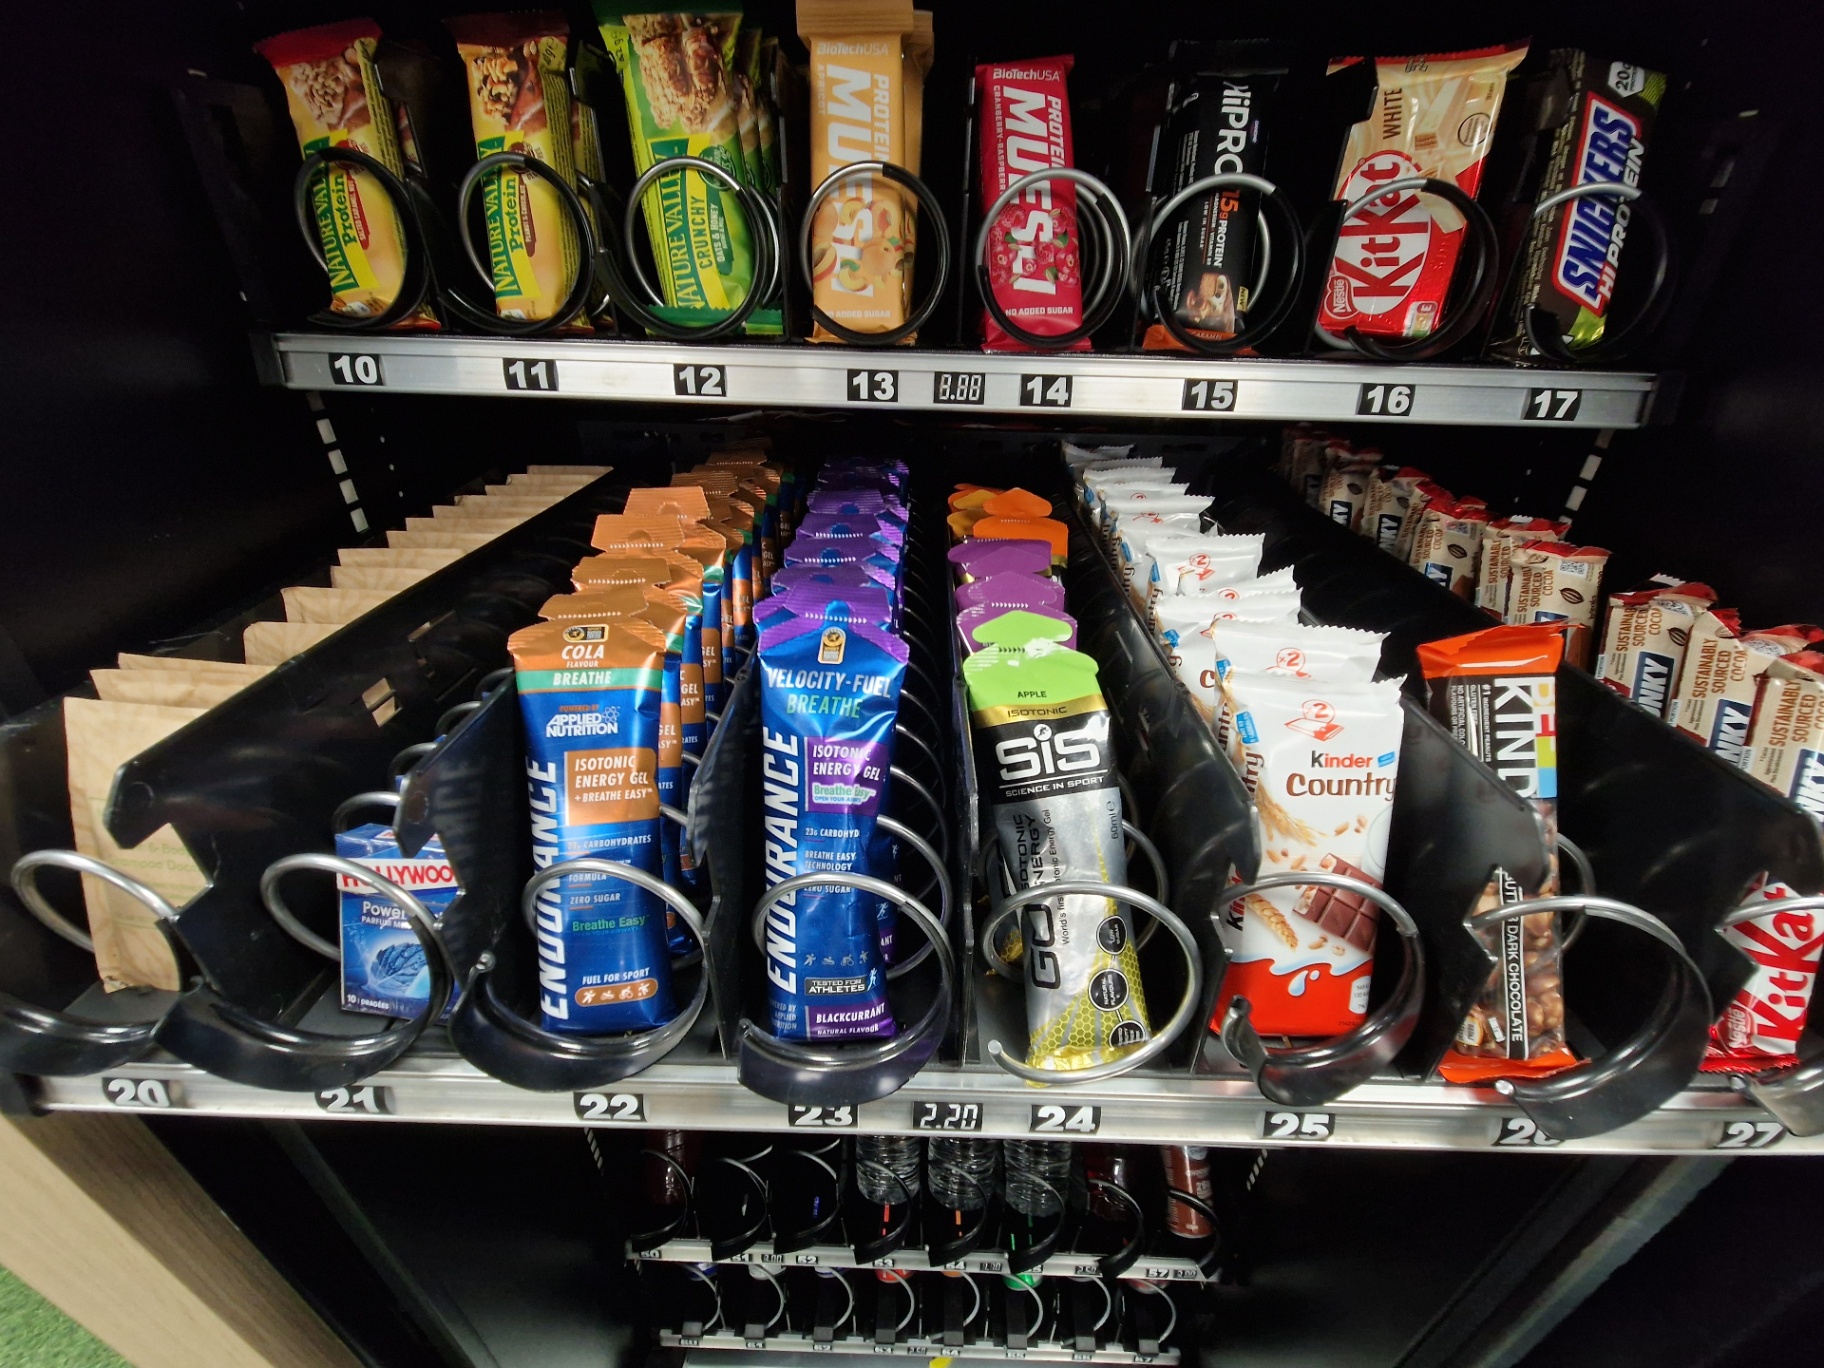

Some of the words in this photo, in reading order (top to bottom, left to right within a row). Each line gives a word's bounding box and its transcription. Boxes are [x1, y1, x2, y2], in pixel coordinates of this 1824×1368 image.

[993, 68, 1061, 82] BioTechUSA
[1383, 88, 1403, 140] WHITE
[1047, 95, 1066, 168] PROTEI
[333, 173, 358, 247] Protein
[503, 177, 525, 252] Protein
[1607, 135, 1646, 267] PROEIN
[710, 203, 719, 231] HONEY
[690, 195, 714, 270] CRUNCHY
[712, 232, 721, 240] &
[1213, 220, 1229, 268] PROTEIN
[319, 213, 358, 289] NATURE
[489, 216, 520, 291] NATURE
[713, 241, 726, 263] OATS
[1240, 288, 1248, 308] NEW
[1333, 279, 1349, 313] Nestlé
[1018, 307, 1046, 316] ADDED
[1047, 306, 1074, 315] SUGAR
[334, 355, 378, 385] 10
[508, 361, 549, 389] 11
[678, 366, 721, 395] 12
[852, 373, 895, 400] 13
[1025, 376, 1070, 405] 14
[1189, 381, 1233, 410] 15
[1365, 386, 1411, 415] 16
[1532, 390, 1579, 419] 17
[1529, 572, 1543, 608] SOURCED
[1616, 607, 1635, 652] SUSTAINAB
[561, 645, 605, 660] COLA
[553, 671, 612, 685] BREATHE
[1692, 638, 1718, 699] SUSTAINABLY
[1711, 650, 1731, 694] SOURCED
[1017, 690, 1047, 699] APPLE
[1457, 684, 1464, 695] NO
[548, 713, 602, 726] APPLIED
[786, 694, 863, 719] BREATHE
[1007, 706, 1068, 718] ISOTONIC
[1457, 695, 1465, 727] ARTIFICIAL
[1769, 679, 1799, 748] SUSTAINABLY
[1792, 694, 1816, 743] SOURCED
[546, 722, 619, 738] NUTRITION
[575, 755, 637, 771] ISOTONIC
[813, 744, 872, 762] ISOTONIC
[995, 724, 1101, 781] SiS
[1311, 750, 1373, 768] Kinder
[575, 773, 625, 788] ENERGY
[630, 771, 649, 785] GEL
[813, 762, 861, 776] ENERGY
[863, 765, 881, 781] GEL
[813, 783, 852, 796] Breathe
[1005, 784, 1050, 797] SCIENCE
[1052, 782, 1065, 790] IN
[1067, 775, 1105, 788] SPORT
[1286, 771, 1397, 802] Country
[1042, 809, 1052, 825] Gel
[583, 834, 652, 849] CARBOHYDRATES
[1013, 814, 1030, 890] SOTONIC
[1025, 814, 1045, 885] NERGY
[1047, 826, 1057, 856] Energy
[804, 861, 853, 871] TECHNOLOGY
[805, 851, 834, 861] BREATHE
[836, 852, 856, 861] EASY
[340, 865, 454, 888] HLLYWOO
[824, 885, 852, 894] SUGAR
[569, 895, 591, 905] ZERO
[593, 893, 621, 903] SUGAR
[1056, 895, 1064, 910] firs
[572, 919, 615, 932] Breathe
[1059, 912, 1070, 945] World's
[1507, 925, 1519, 960] DARK
[582, 975, 602, 985] FUEL
[604, 973, 621, 983] FOR
[623, 967, 650, 982] SPORT
[808, 983, 866, 993] ATHLETES
[844, 978, 862, 986] FOR
[1108, 974, 1116, 1005] FLAVOURS
[346, 994, 357, 1004] 10
[1101, 976, 1109, 1005] NATURAL
[1508, 962, 1524, 1042] CHOCOLATE
[816, 1003, 886, 1024] BLACKCURRANT
[817, 1027, 847, 1036] NATURAL
[107, 1079, 170, 1108] 20
[321, 1086, 380, 1113] 21
[579, 1093, 641, 1120] 22
[794, 1105, 853, 1126] 23
[920, 1102, 978, 1130] 2.20
[1035, 1105, 1096, 1132] 24
[1270, 1112, 1330, 1140] 25
[1717, 1121, 1784, 1148] 27
